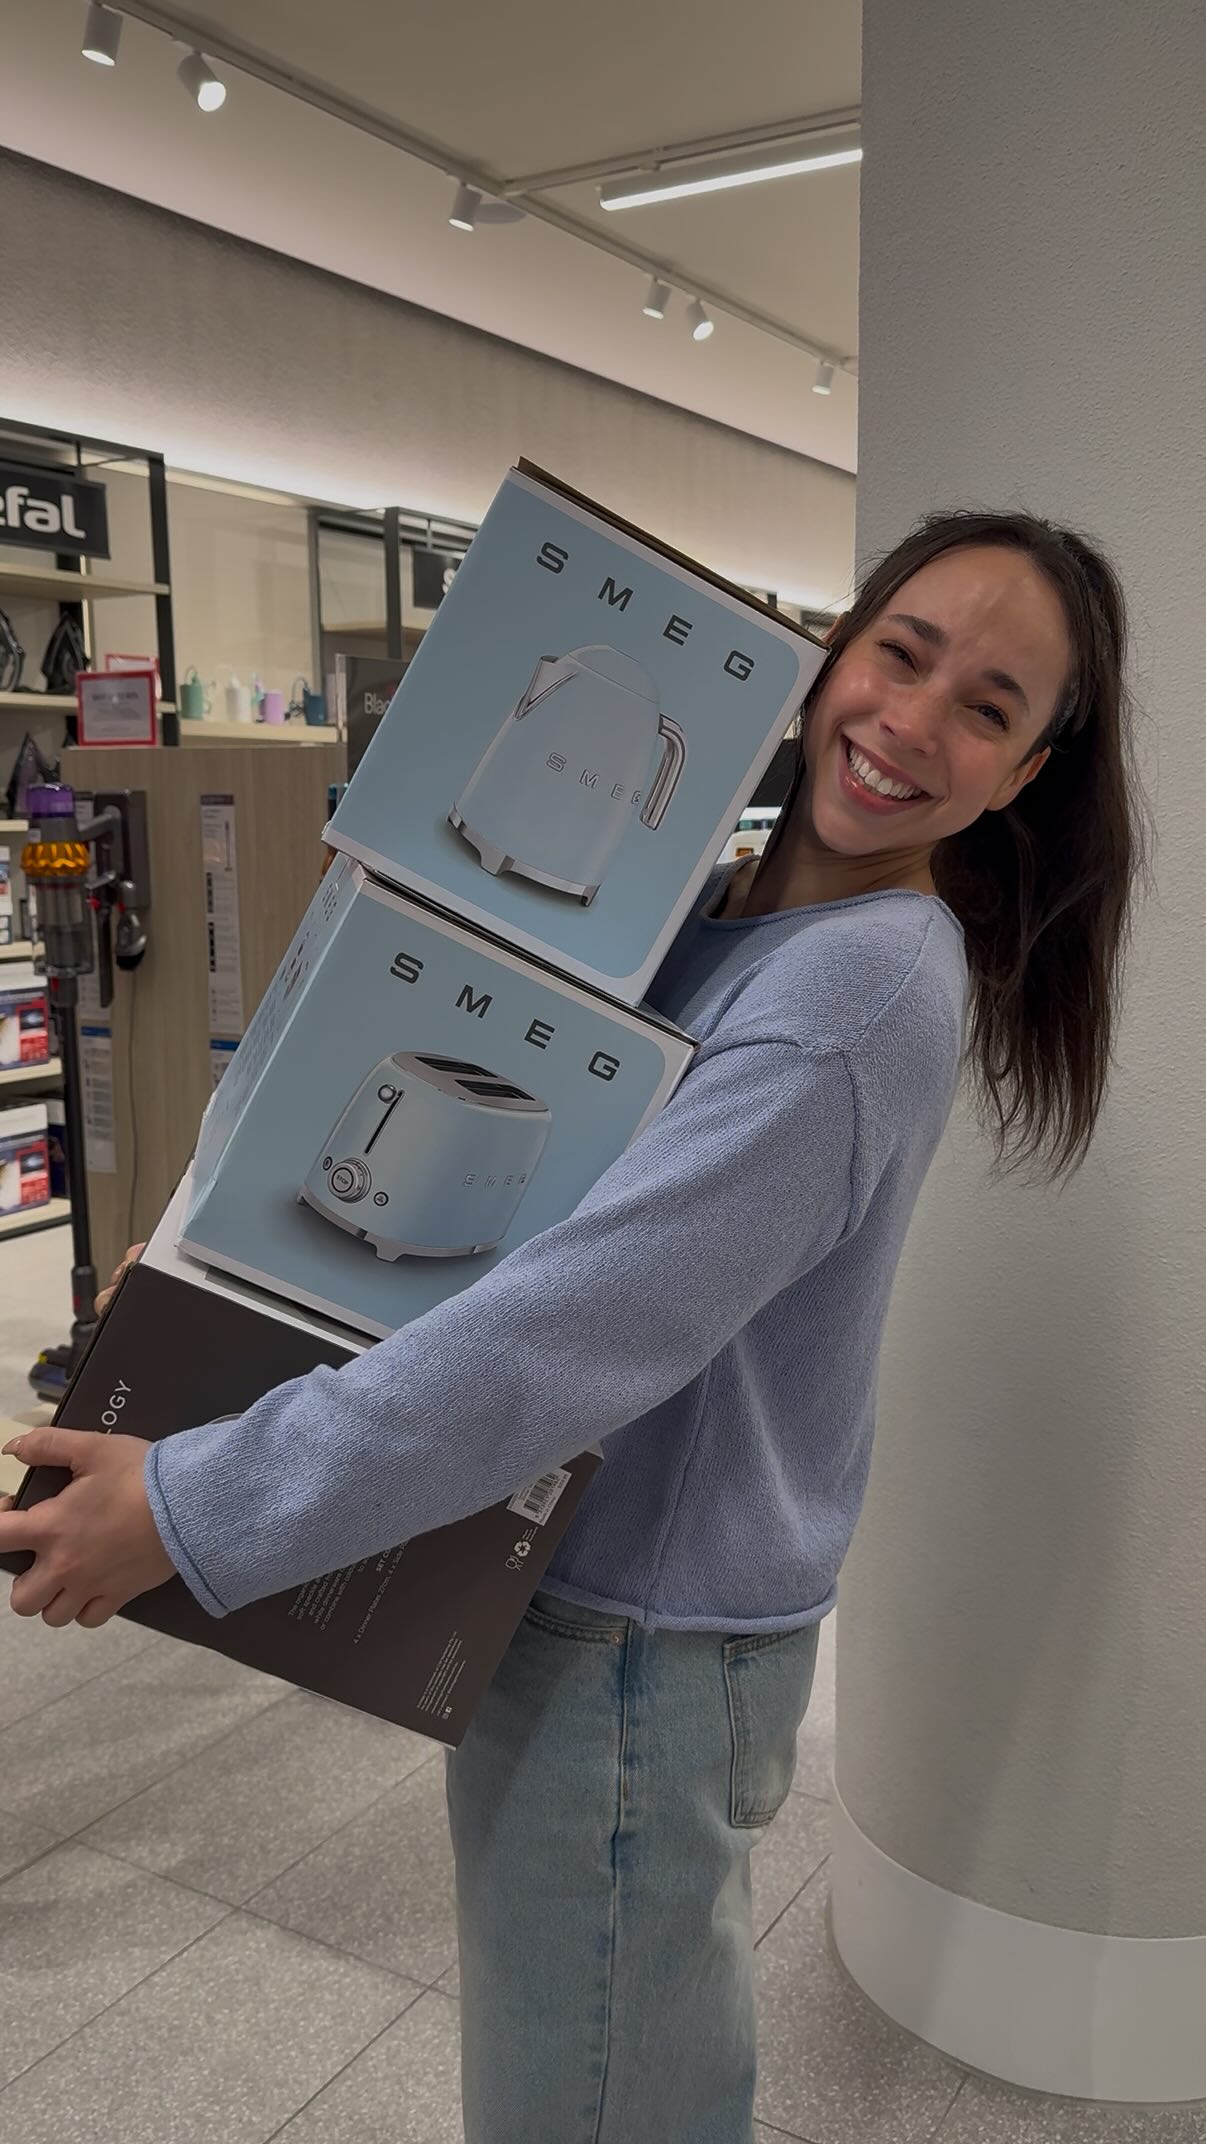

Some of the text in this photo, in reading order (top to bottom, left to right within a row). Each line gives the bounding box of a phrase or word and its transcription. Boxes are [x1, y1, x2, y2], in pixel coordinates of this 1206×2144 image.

[0, 485, 87, 539] fal
[536, 541, 755, 682] SMEG
[390, 952, 620, 1082] SMEG
[101, 1379, 131, 1434] OGY
[376, 1558, 385, 1572] SET
[358, 1612, 371, 1633] Dinner
[369, 1594, 380, 1613] Plates
